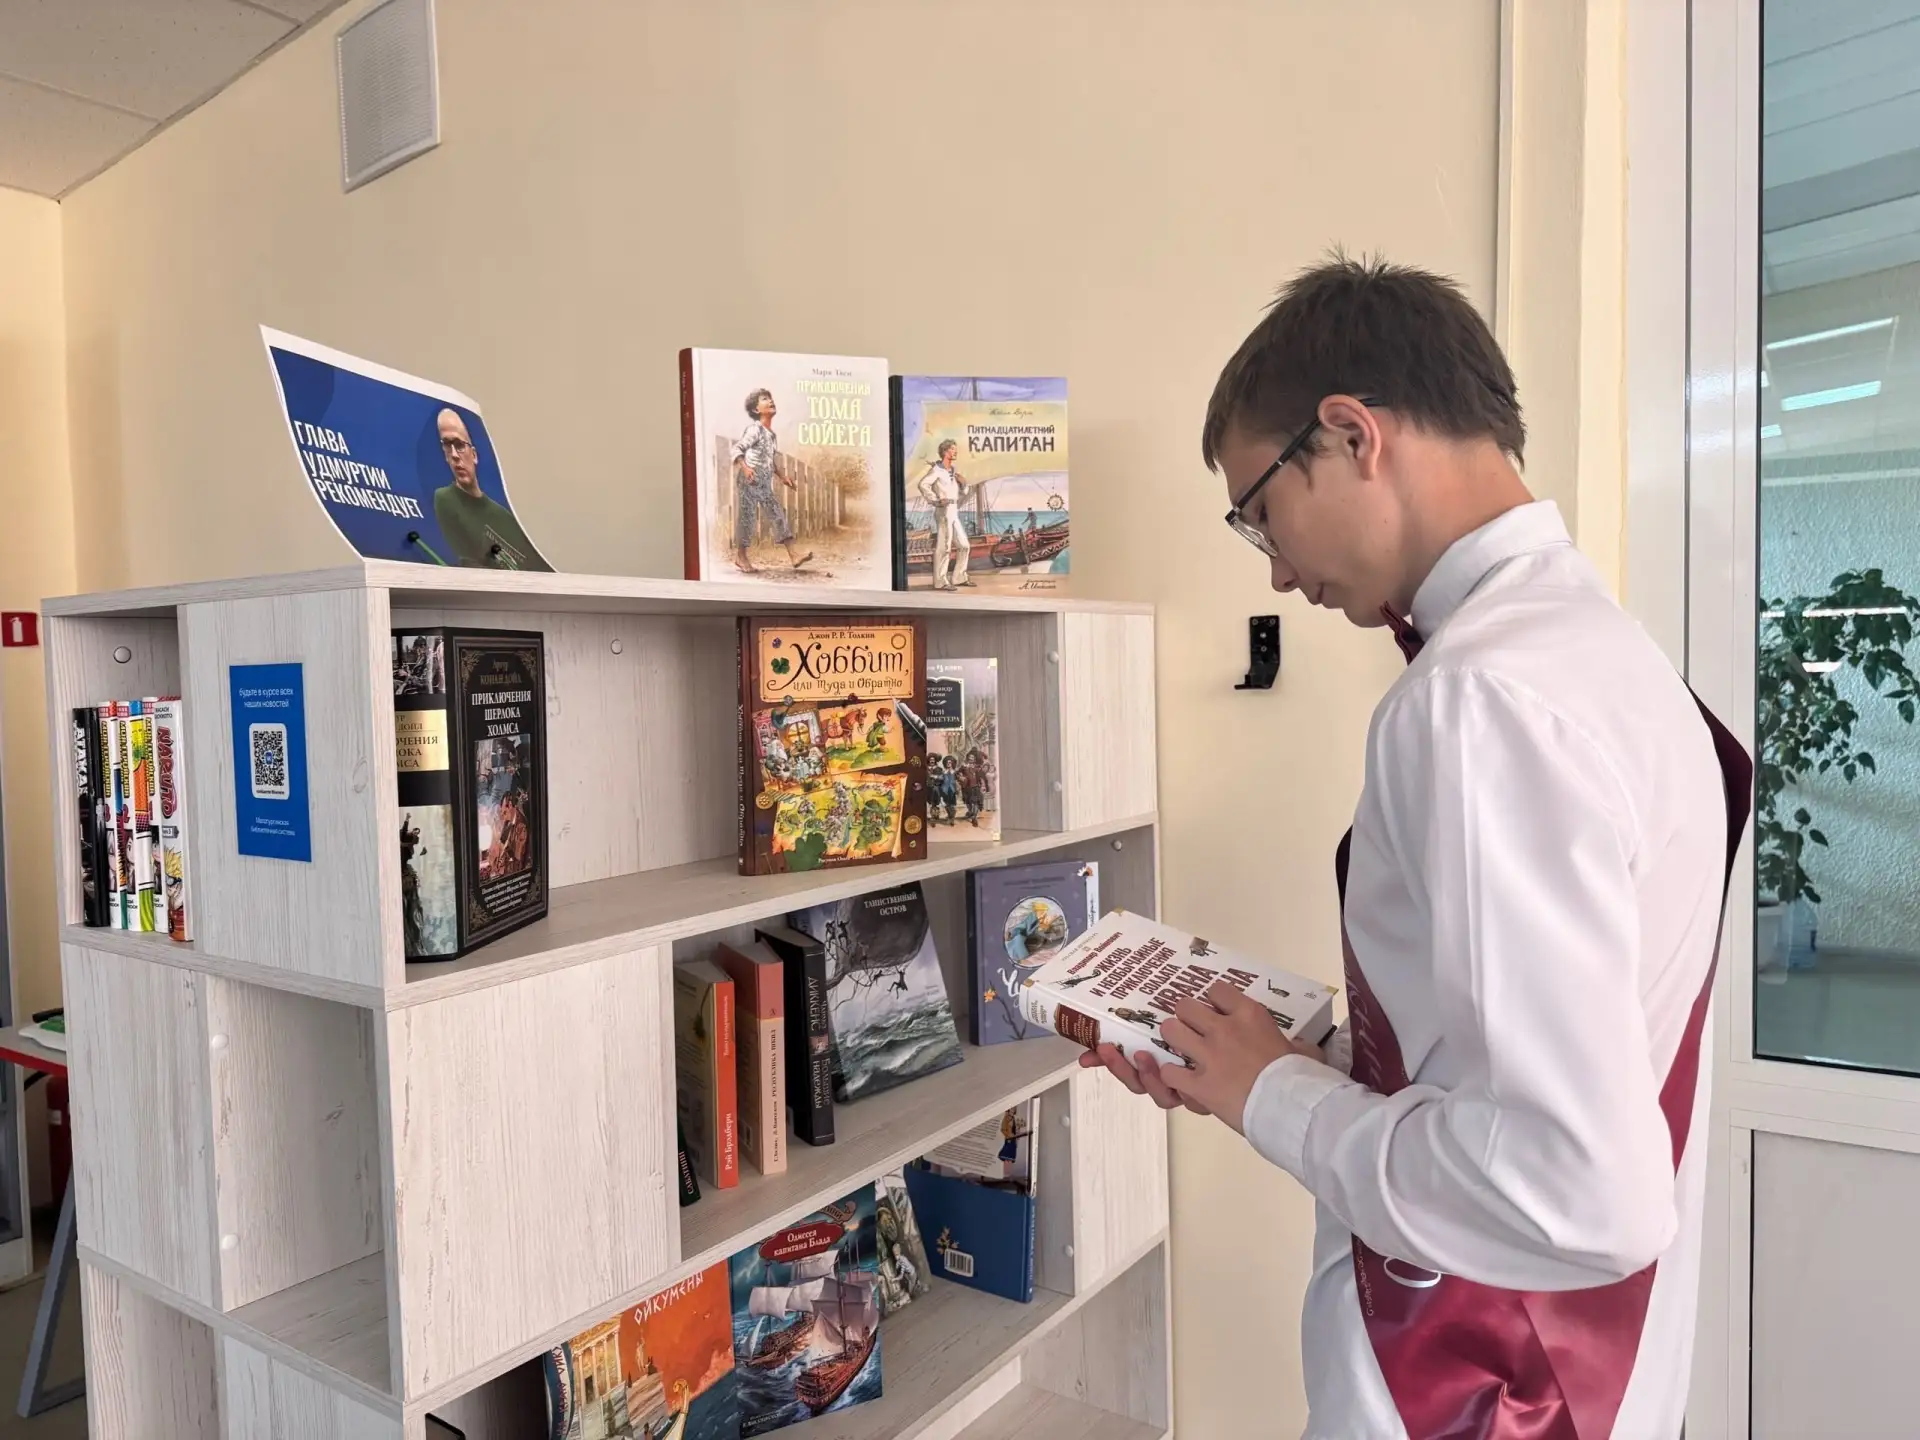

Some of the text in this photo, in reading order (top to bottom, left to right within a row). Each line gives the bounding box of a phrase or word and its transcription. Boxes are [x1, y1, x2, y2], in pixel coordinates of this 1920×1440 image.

[796, 379, 871, 396] ПРИКЛЮЧЕНИЯ
[806, 395, 863, 421] ТОМА
[293, 420, 351, 456] ГЛАВА
[797, 419, 872, 447] СОЙЕРА
[968, 436, 1055, 453] КАПИТАН
[303, 449, 392, 491] УДМУРТИИ
[313, 478, 425, 519] РЕКОМЕНДУЕТ
[807, 631, 830, 640] Джон
[848, 631, 875, 640] Толкин
[766, 641, 910, 691] Хоббит,
[471, 690, 532, 706] ПРИКЛЮЧЕНИЯ
[793, 680, 813, 691] или
[848, 680, 855, 690] и
[484, 706, 521, 721] ШЕРЛОКА
[487, 722, 520, 737] ХОЛМСА
[397, 748, 423, 757] ОКА
[157, 726, 178, 819] NARUTO
[863, 890, 918, 909] ТАИНСТВЕННЫЙ
[879, 904, 907, 916] ОСТРОВ
[1066, 950, 1099, 975] Владимир
[1093, 931, 1123, 954] Войнович
[1096, 947, 1132, 973] ЖИЗНЬ
[1089, 987, 1107, 998] И
[1100, 937, 1166, 991] НЕОБЫЧАЙНЫЕ
[1109, 946, 1178, 1000] ПРИКЛЮЧЕНИЯ
[1138, 963, 1183, 996] СОЛДАТА
[1147, 964, 1220, 1016] ИВАНА
[807, 976, 821, 1032] ДИККЕНС
[724, 1112, 735, 1170] Рэй Брэдбери
[773, 1235, 832, 1257] капитана Блада
[787, 1229, 817, 1243] Одиссея
[633, 1271, 705, 1326] ОЙКУМЕНЫ
